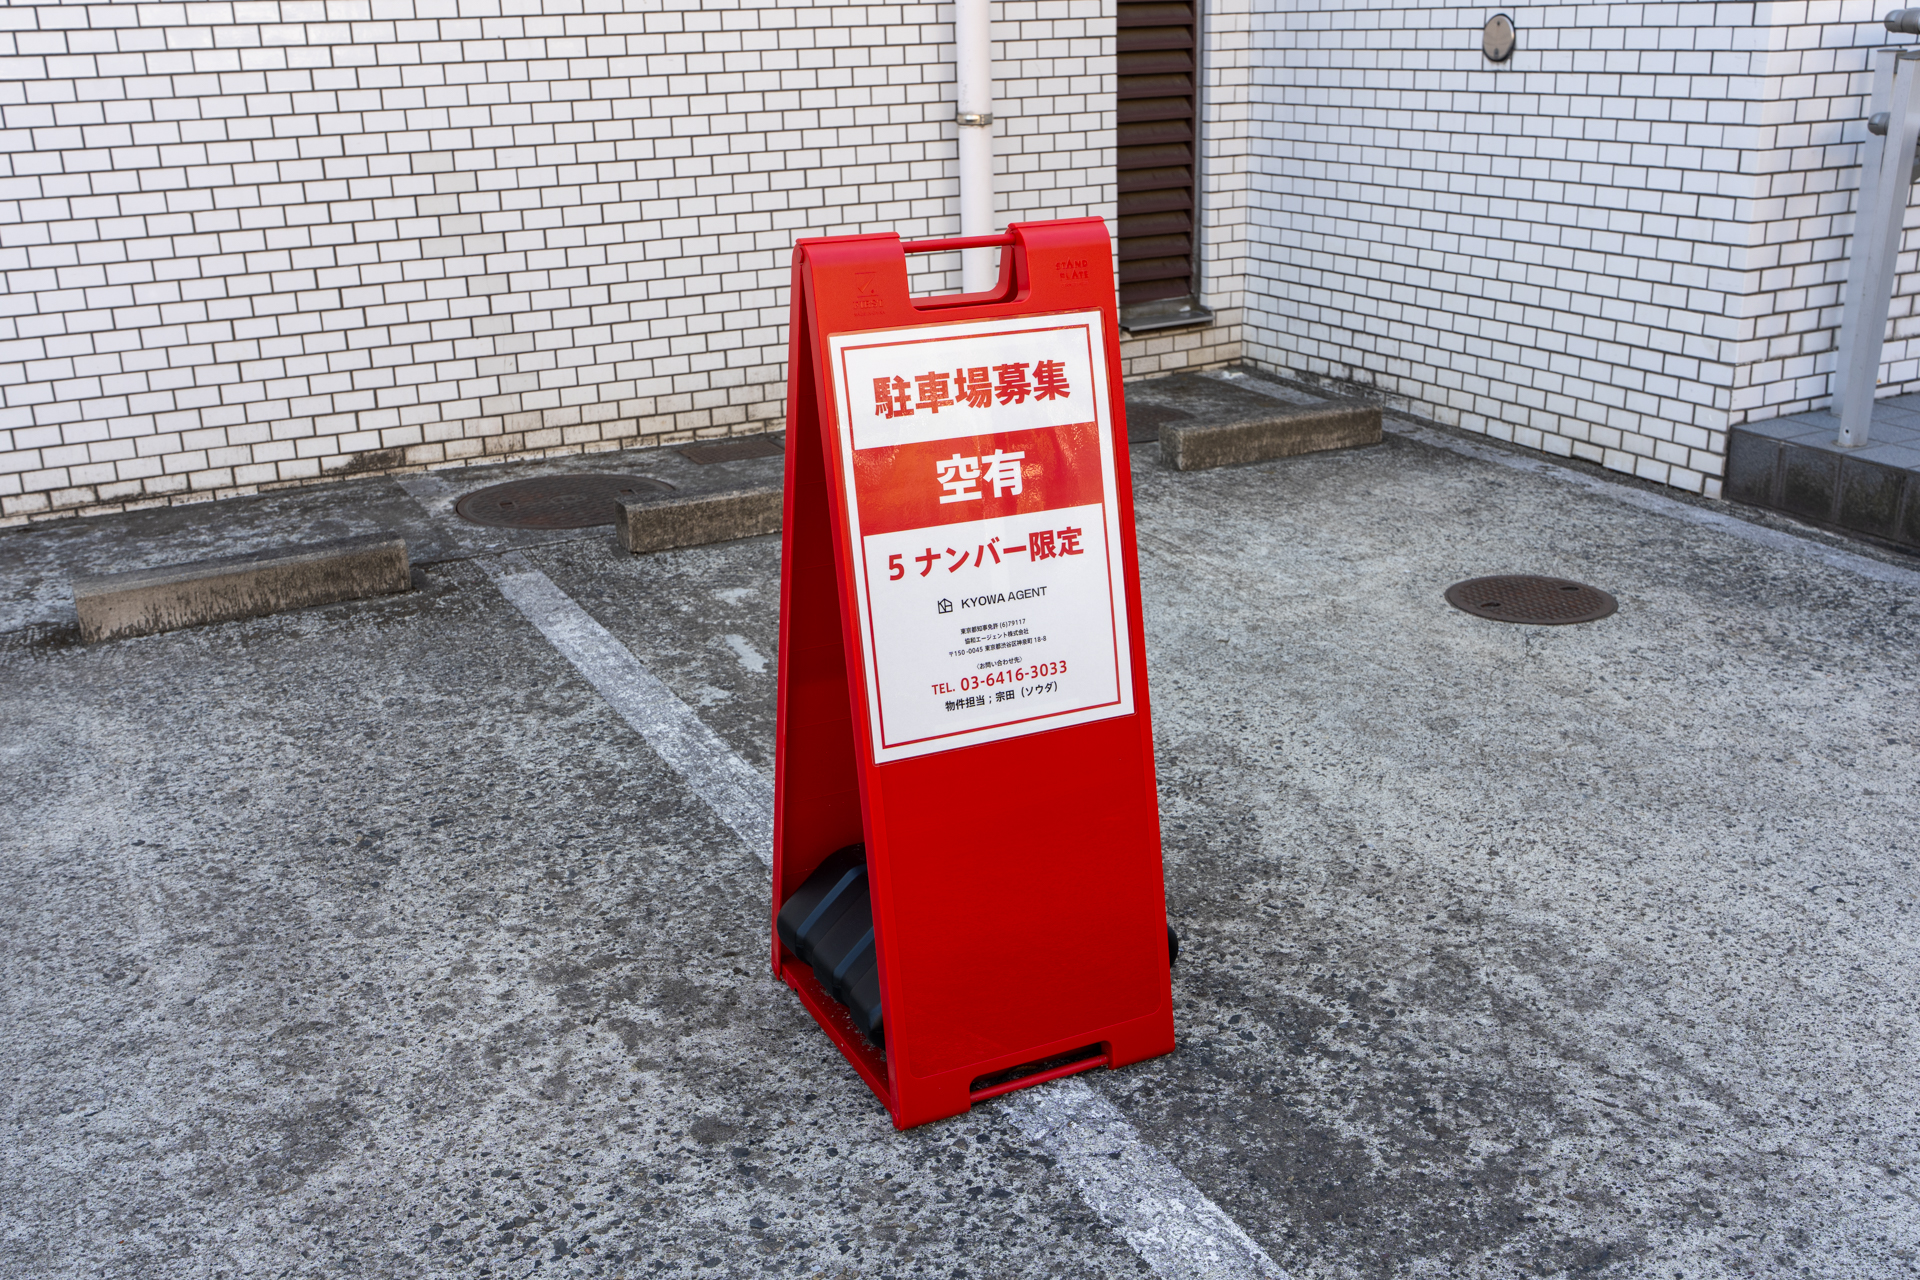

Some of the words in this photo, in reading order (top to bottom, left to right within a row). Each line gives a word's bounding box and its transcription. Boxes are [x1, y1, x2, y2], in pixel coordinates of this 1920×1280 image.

[1055, 258, 1088, 270] STAND
[1060, 269, 1089, 281] PLATE
[873, 360, 1070, 419] 駐車場募集
[936, 449, 1026, 504] 空有
[961, 593, 1006, 609] KYOWA
[1007, 586, 1048, 602] AGENT
[964, 628, 1030, 645] 協和エージェント株式会社
[931, 682, 956, 695] TEL.
[960, 660, 1067, 691] 03-6416-3033
